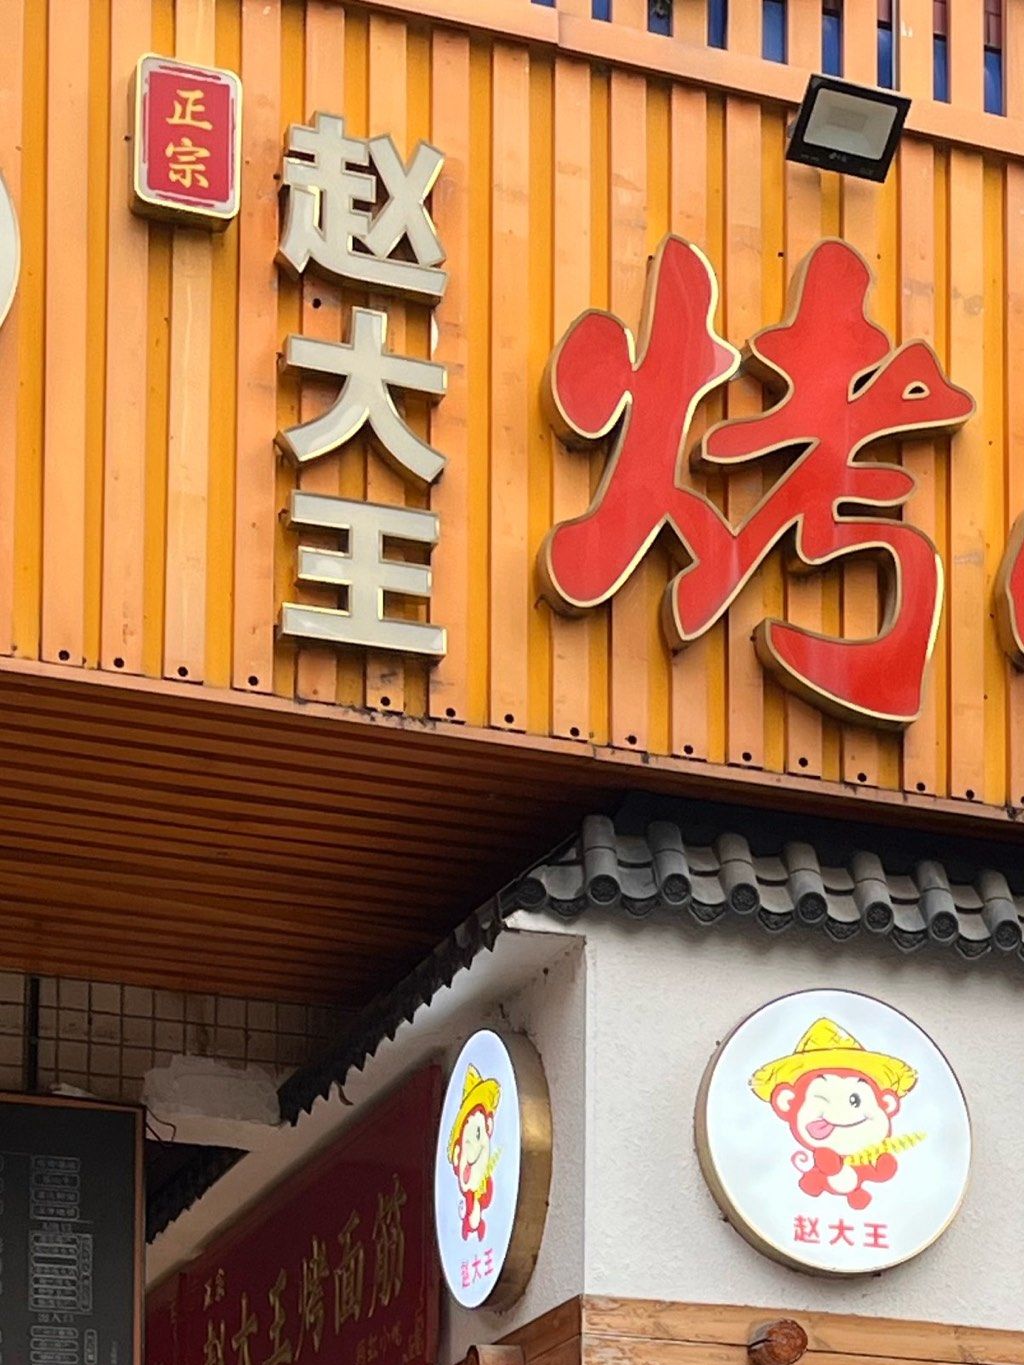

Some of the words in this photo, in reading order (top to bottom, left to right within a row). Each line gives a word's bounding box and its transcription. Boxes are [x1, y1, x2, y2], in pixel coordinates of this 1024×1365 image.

[164, 89, 215, 191] 正宗
[275, 111, 447, 657] 赵大王
[793, 1214, 891, 1249] 赵大王
[460, 1248, 495, 1288] 赵大王
